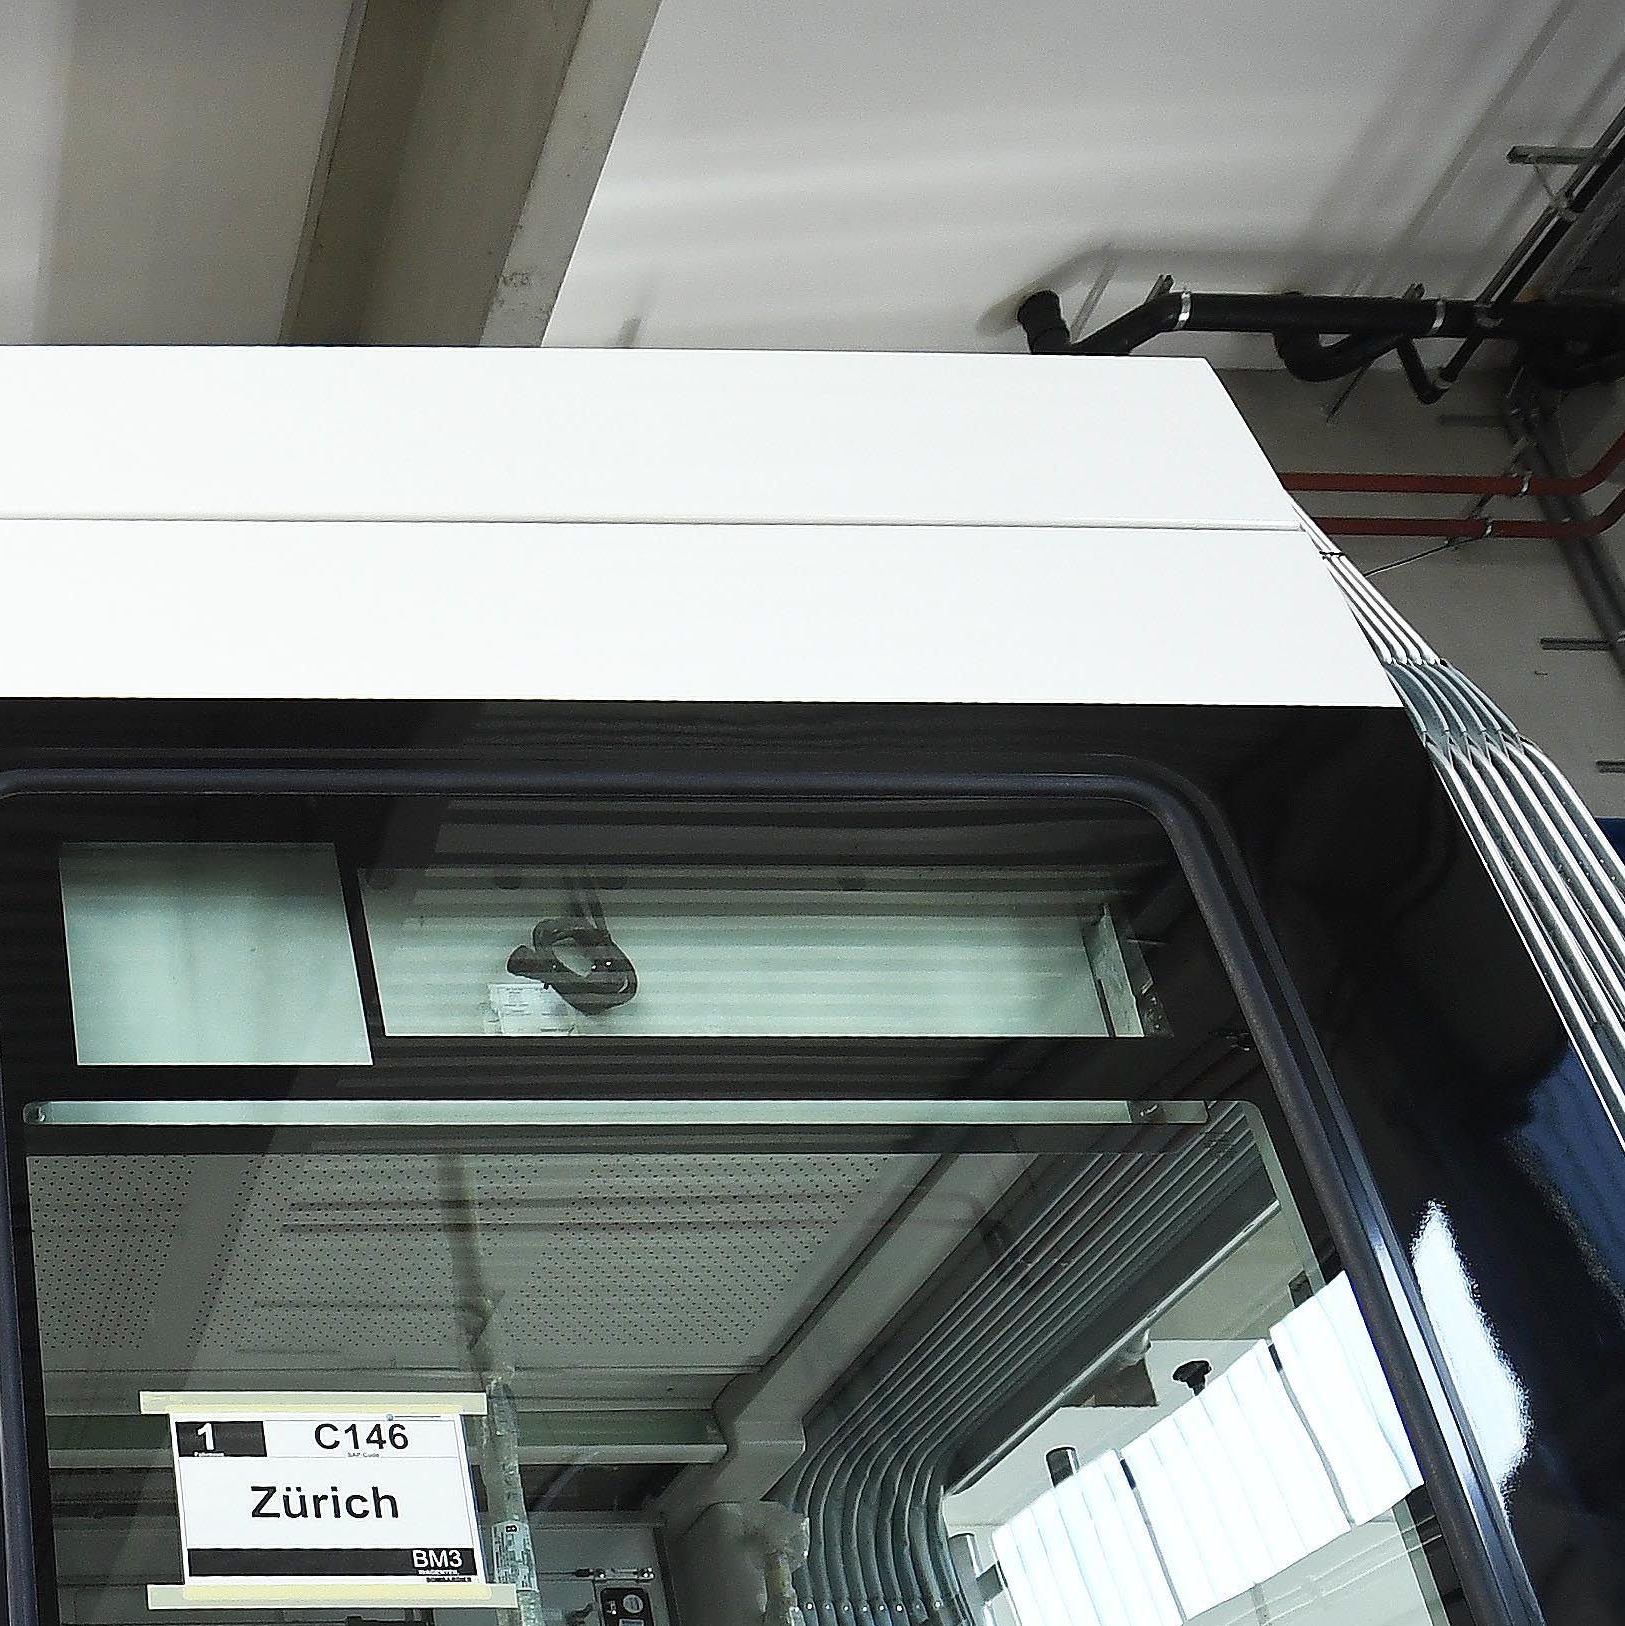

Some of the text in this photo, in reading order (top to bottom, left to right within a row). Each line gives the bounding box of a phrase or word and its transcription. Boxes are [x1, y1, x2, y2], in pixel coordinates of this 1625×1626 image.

[197, 1422, 215, 1451] 1
[314, 1423, 409, 1450] C146
[251, 1485, 399, 1519] Zürich
[412, 1549, 463, 1568] BM3
